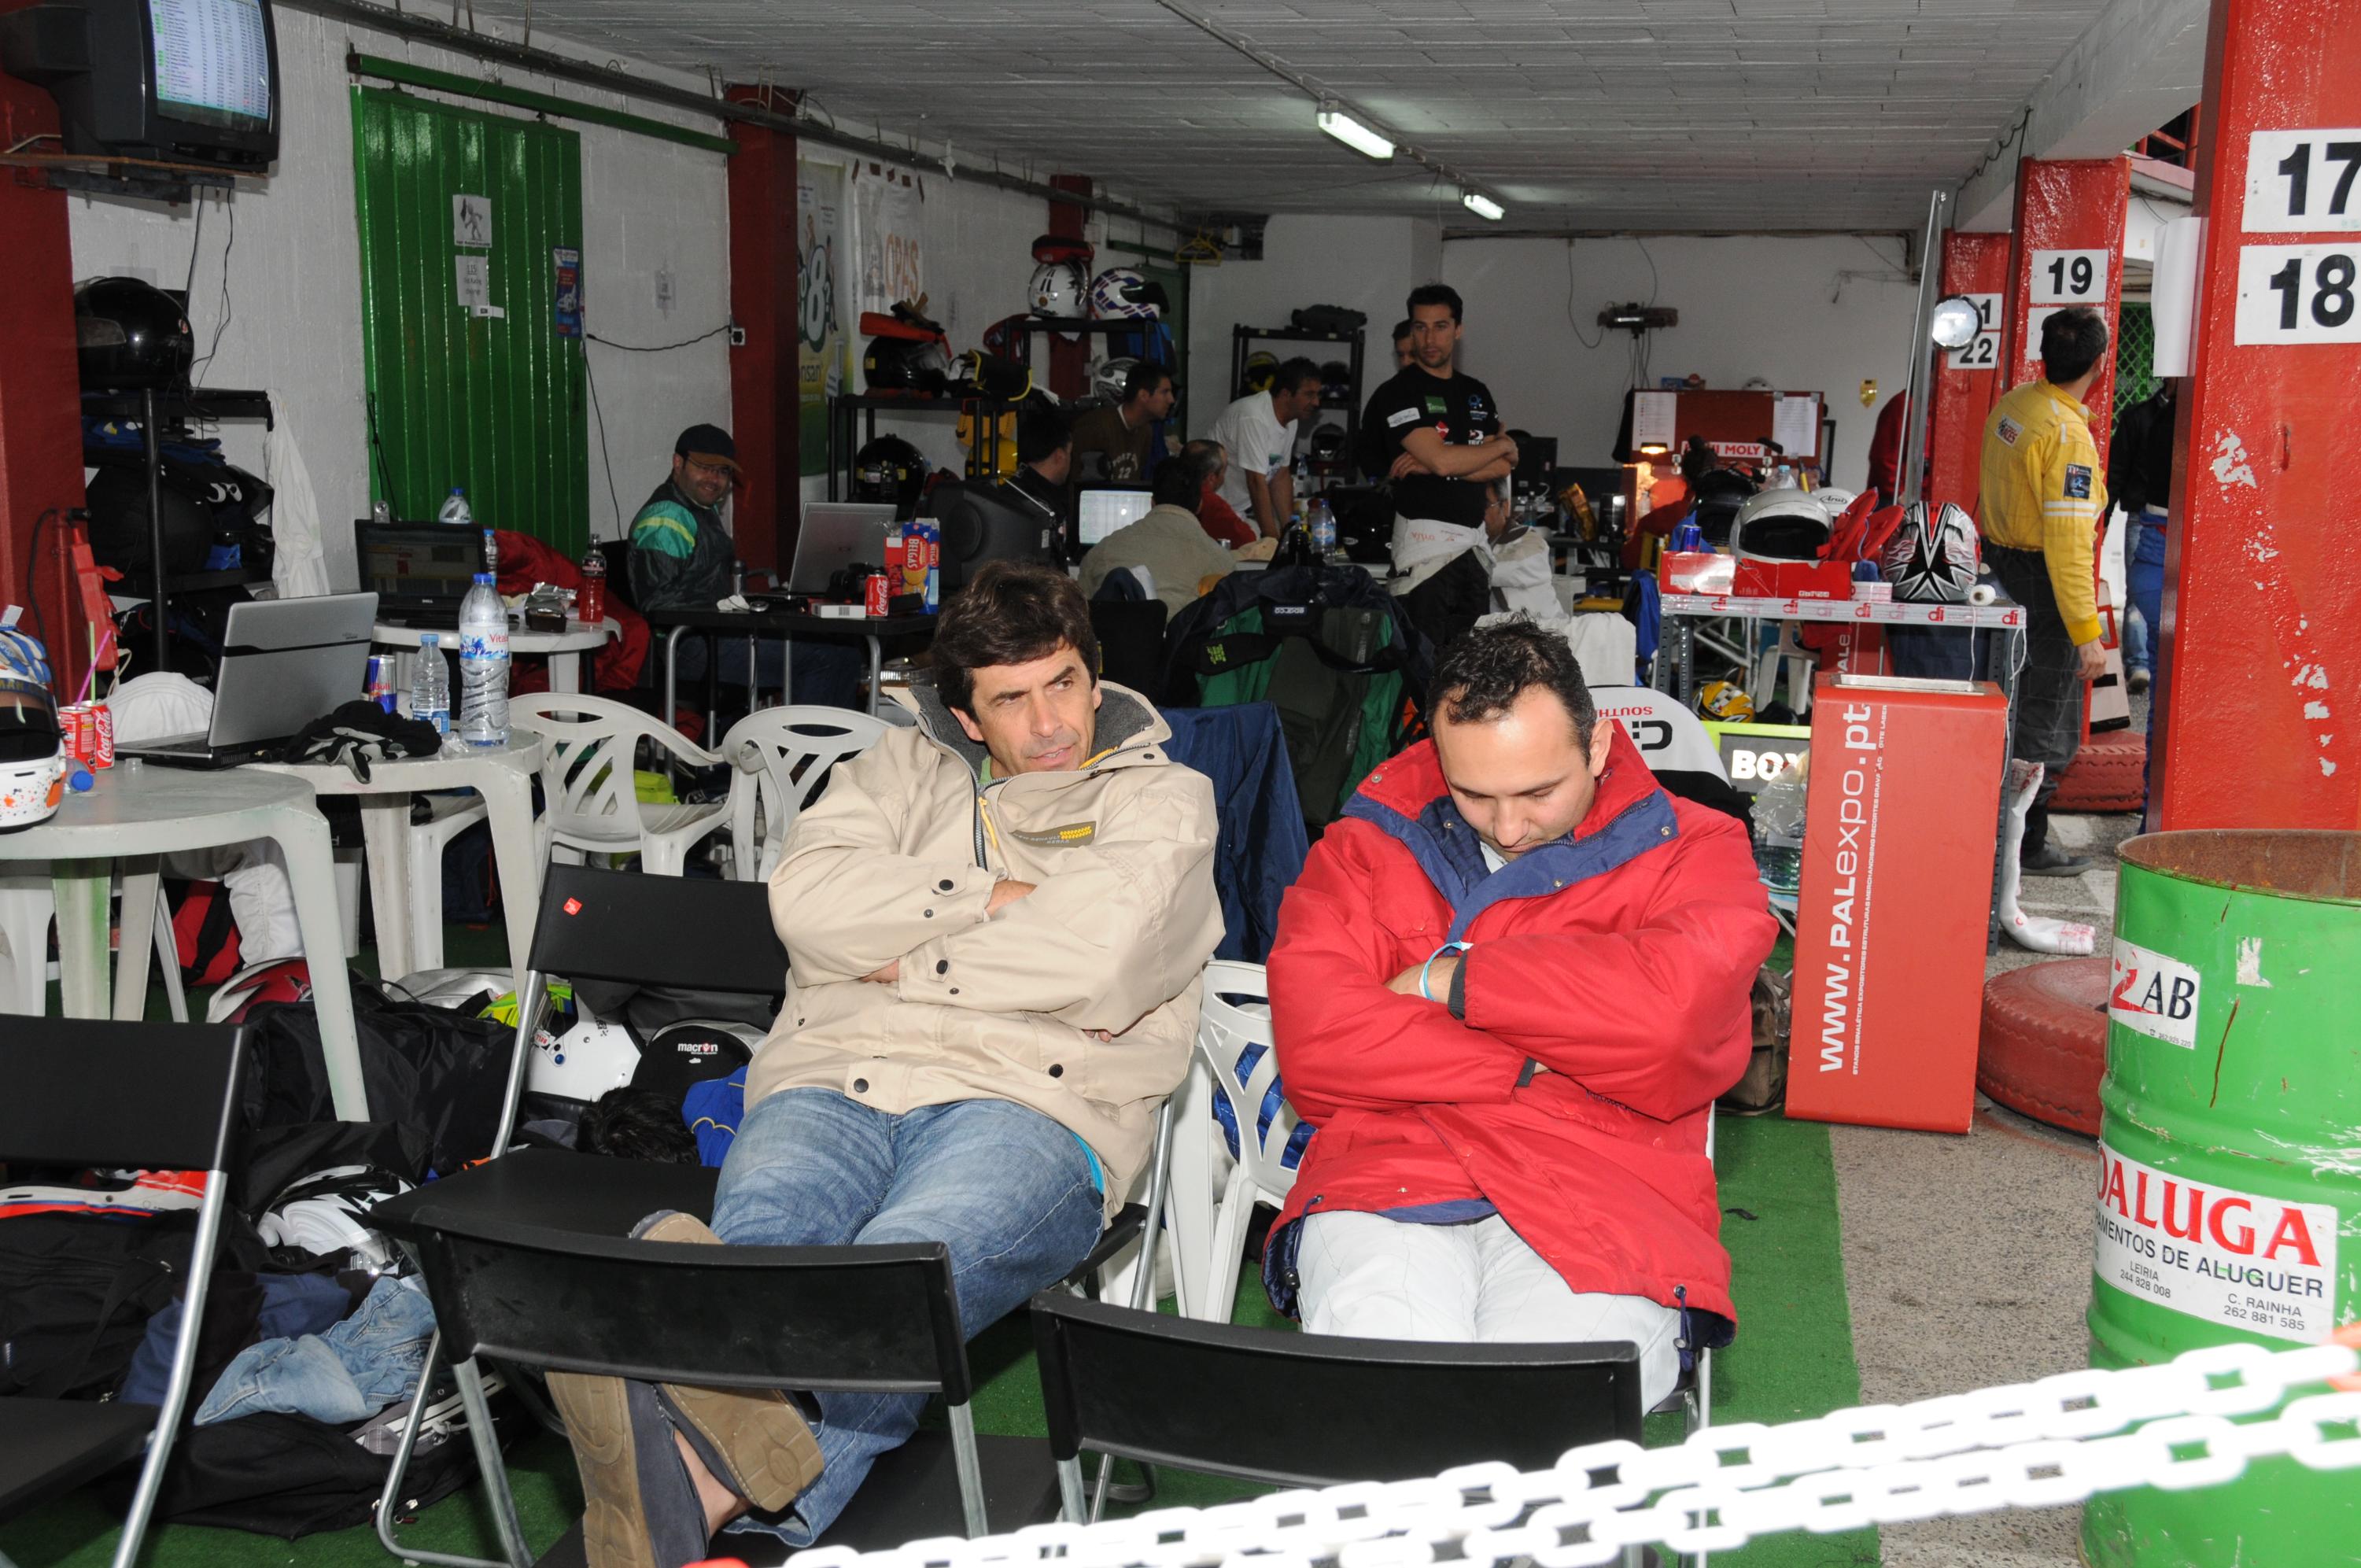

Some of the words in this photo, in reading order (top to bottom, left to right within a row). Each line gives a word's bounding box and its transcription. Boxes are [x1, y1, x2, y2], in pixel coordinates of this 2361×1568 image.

[2278, 142, 2361, 216] 17
[2048, 256, 2093, 295] 19
[2270, 253, 2356, 330] 18
[1959, 338, 1993, 363] 22
[1725, 444, 1762, 456] MOLY
[1825, 495, 1846, 504] Arai
[907, 538, 920, 568] BELGAS
[1599, 706, 1653, 718] SOUTH
[1861, 902, 1871, 950] ESTRUTURAS
[1858, 950, 1868, 1002] EXPOSITORES
[677, 1042, 718, 1053] macron
[2119, 1268, 2134, 1284] 244
[2134, 1274, 2152, 1292] 828
[2153, 1281, 2171, 1299] 008
[2129, 1260, 2160, 1282] LEIRIA
[2162, 1245, 2189, 1271] DE
[2196, 1256, 2323, 1298] ALUGUER
[2223, 1304, 2247, 1320] 262
[2251, 1312, 2274, 1326] 881
[2279, 1317, 2306, 1332] 585
[2227, 1293, 2242, 1306] C.
[2246, 1296, 2303, 1318] RAINHA
